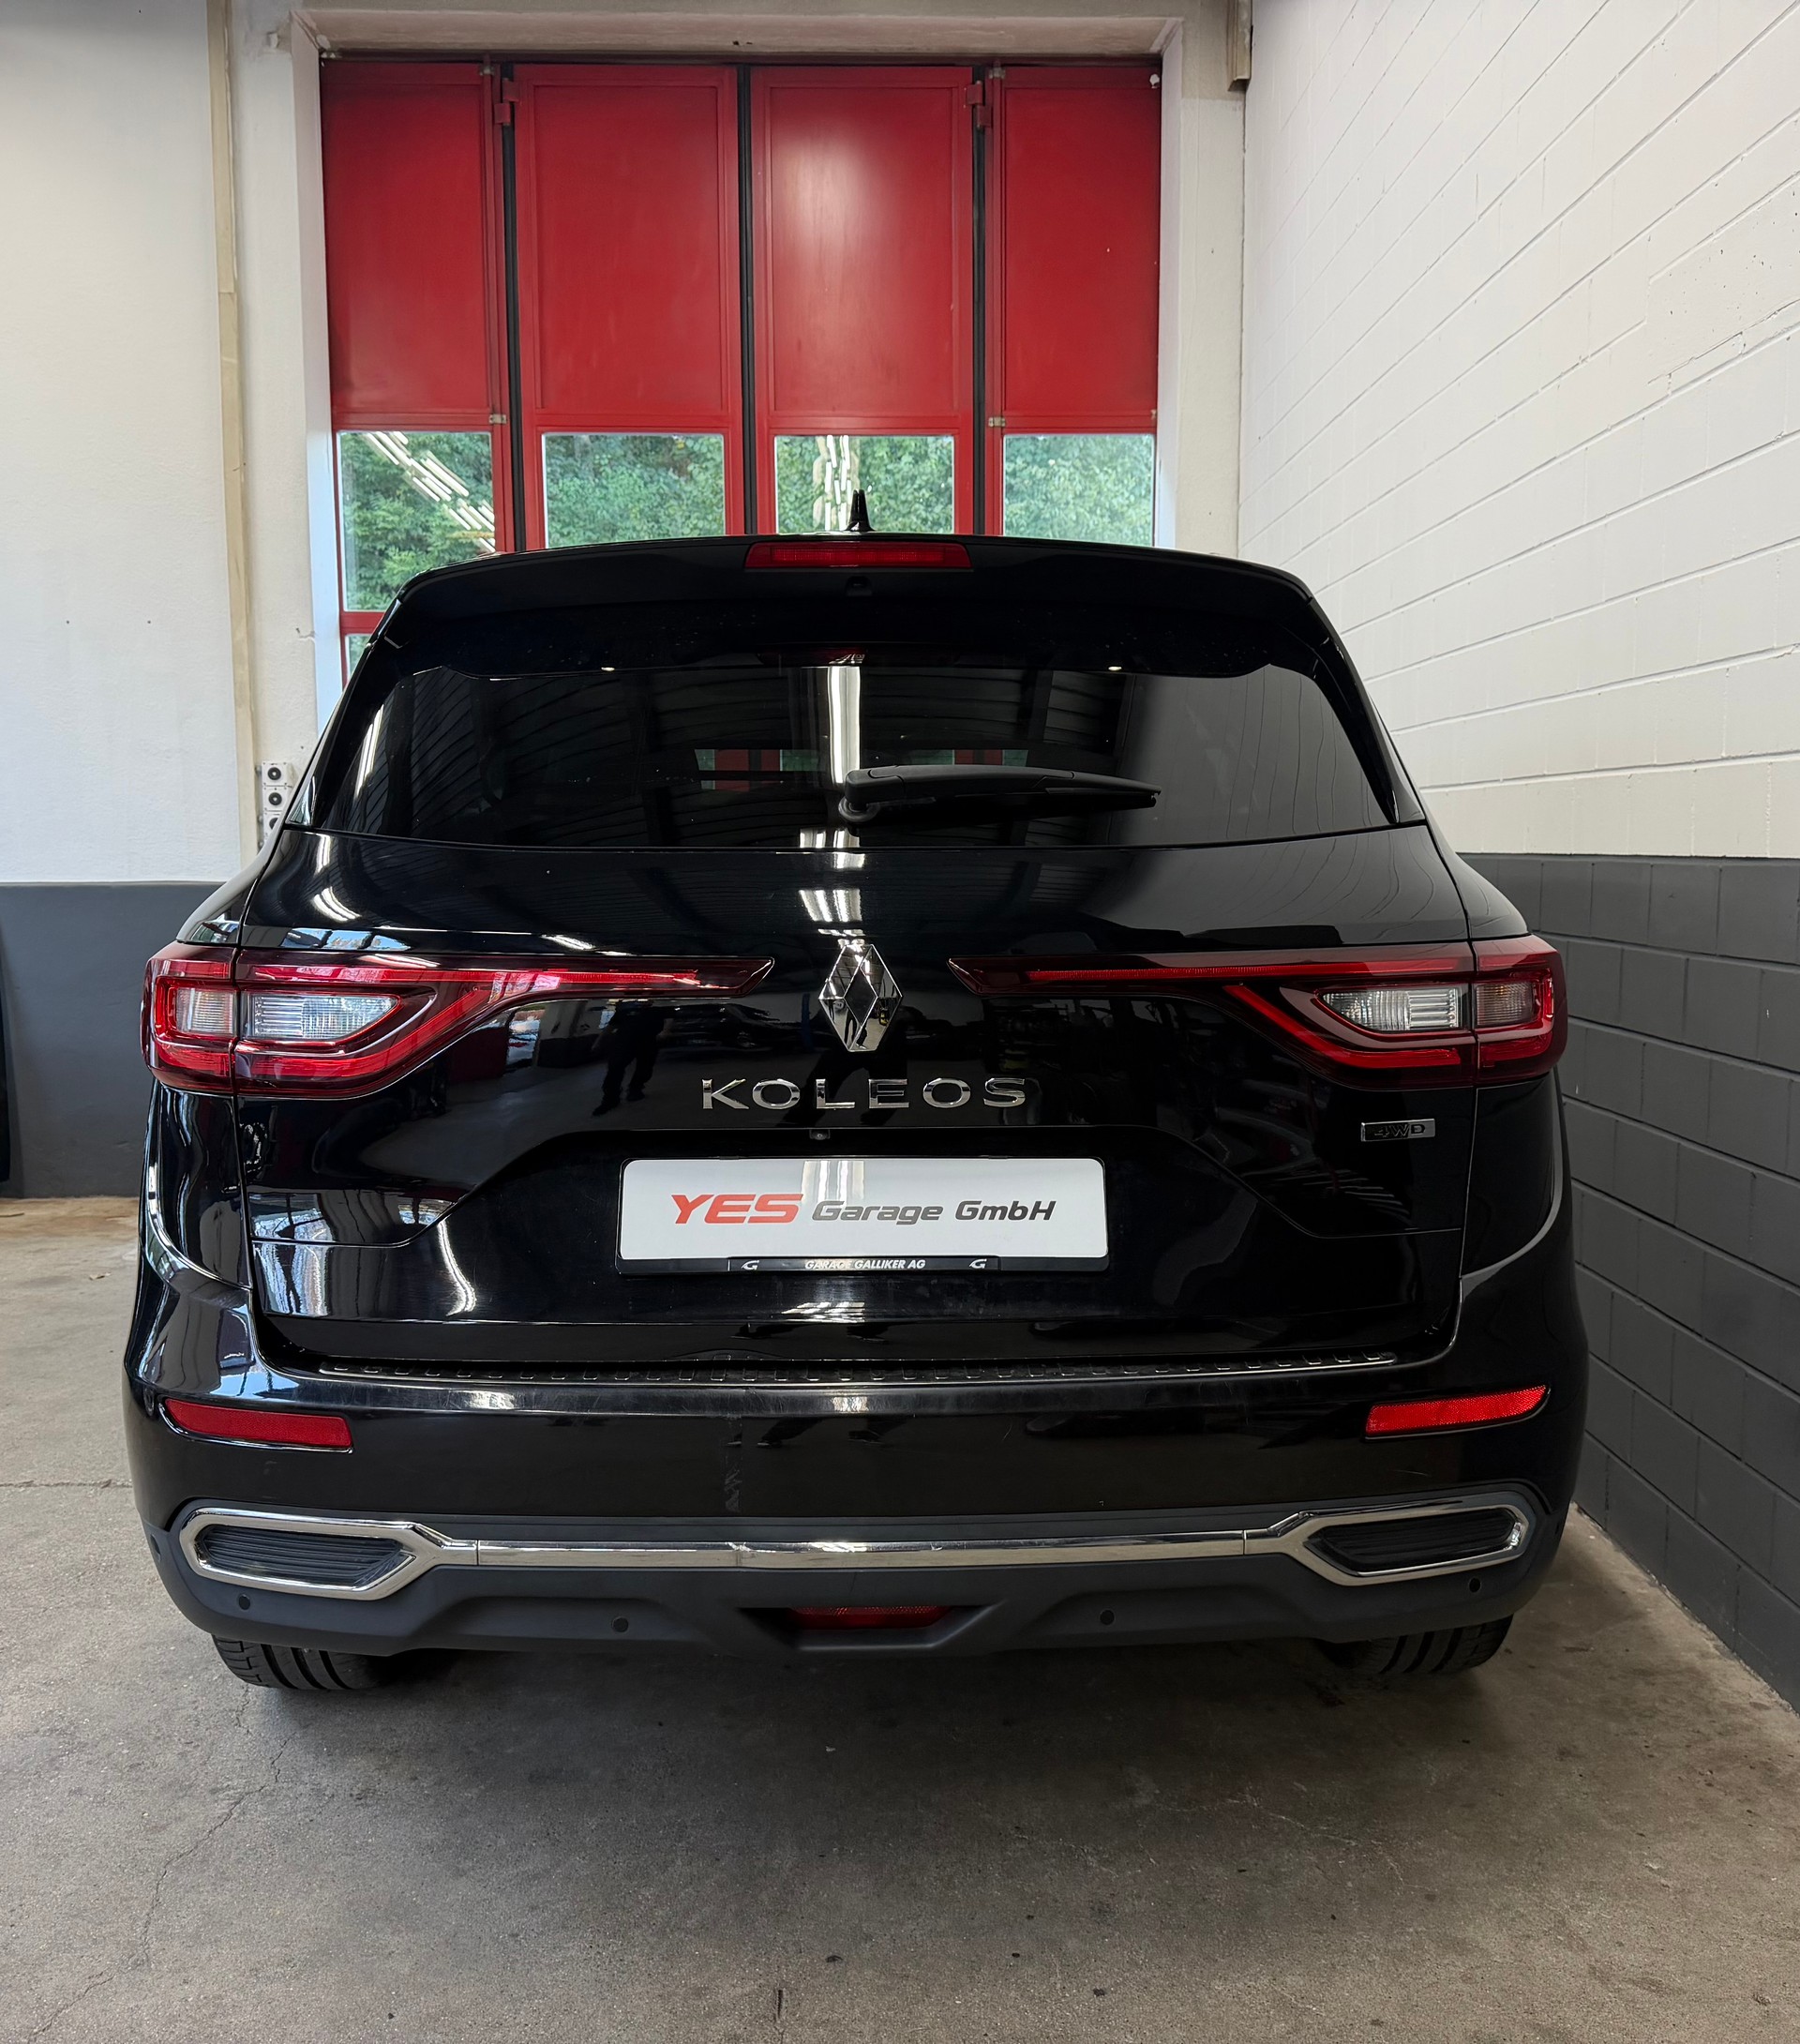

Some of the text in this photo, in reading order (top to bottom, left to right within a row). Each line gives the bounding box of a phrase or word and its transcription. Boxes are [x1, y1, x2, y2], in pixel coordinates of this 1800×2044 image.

[701, 1077, 1026, 1110] KOLEOS
[1373, 1124, 1426, 1137] 4WD
[671, 1193, 1057, 1225] YES Garage GmbH
[854, 1259, 906, 1270] GALLIKER
[907, 1259, 926, 1270] AG
